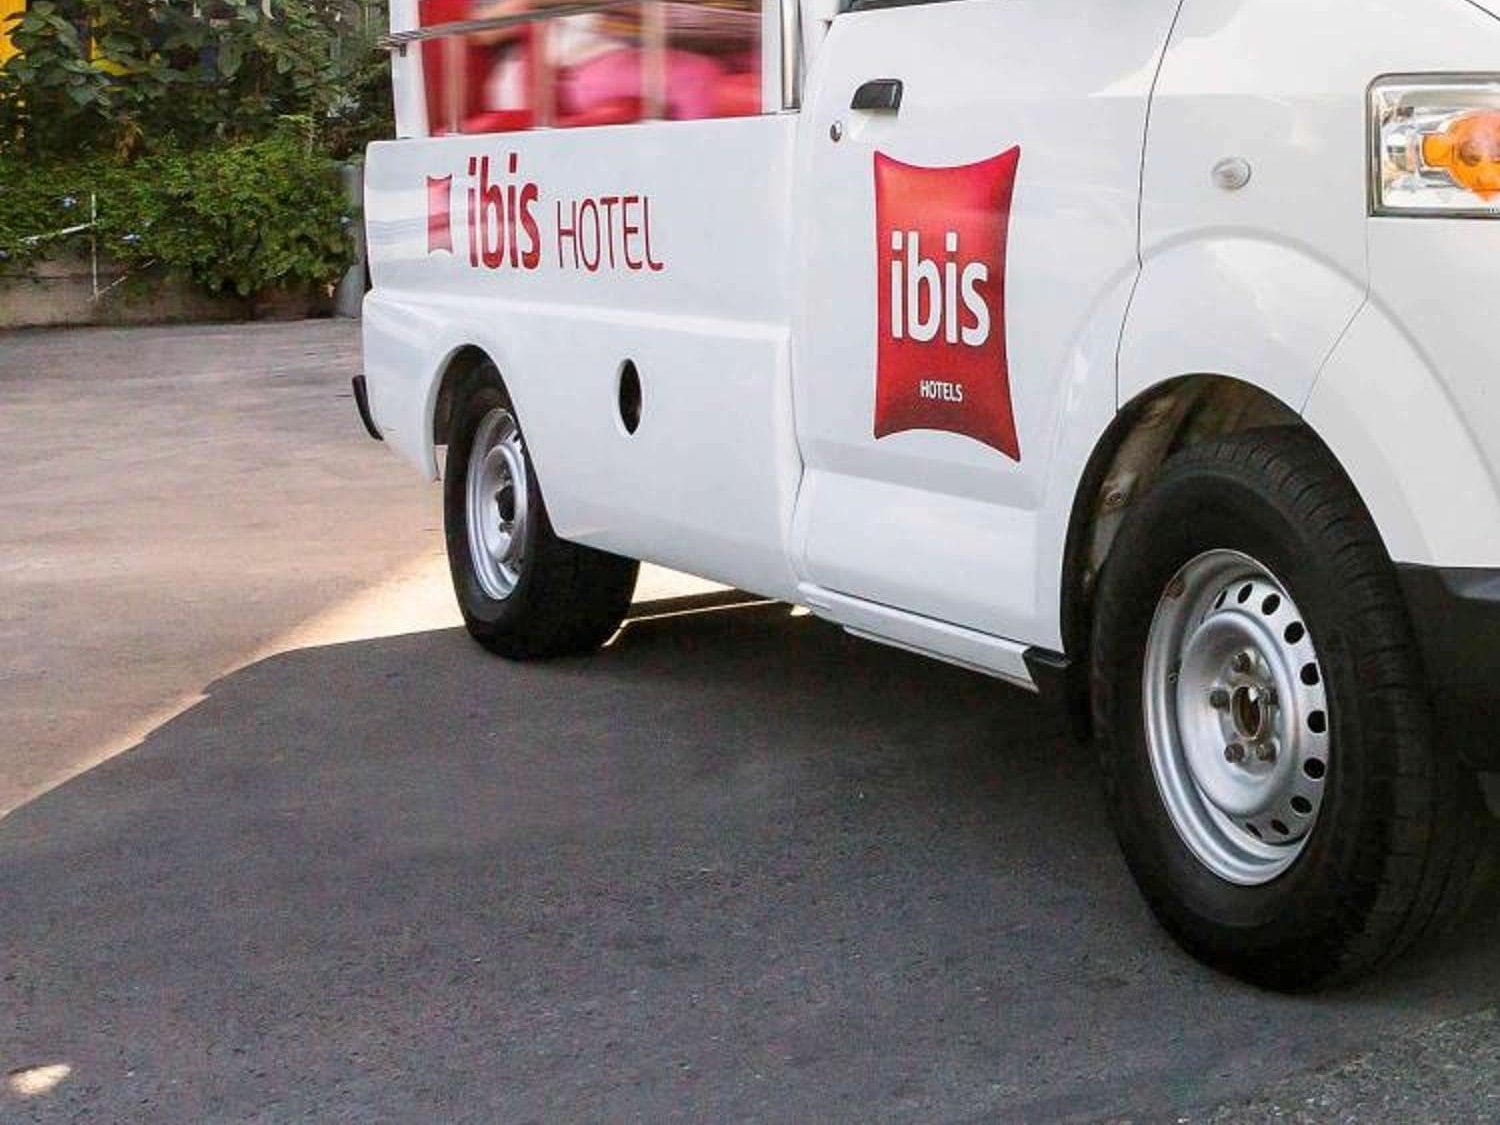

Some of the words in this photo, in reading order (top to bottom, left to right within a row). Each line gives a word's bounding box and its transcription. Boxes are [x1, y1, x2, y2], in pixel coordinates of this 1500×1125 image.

[467, 152, 541, 270] ibis
[556, 196, 664, 272] HOTEL
[890, 229, 991, 347] ibis
[919, 378, 964, 403] HOTELS
